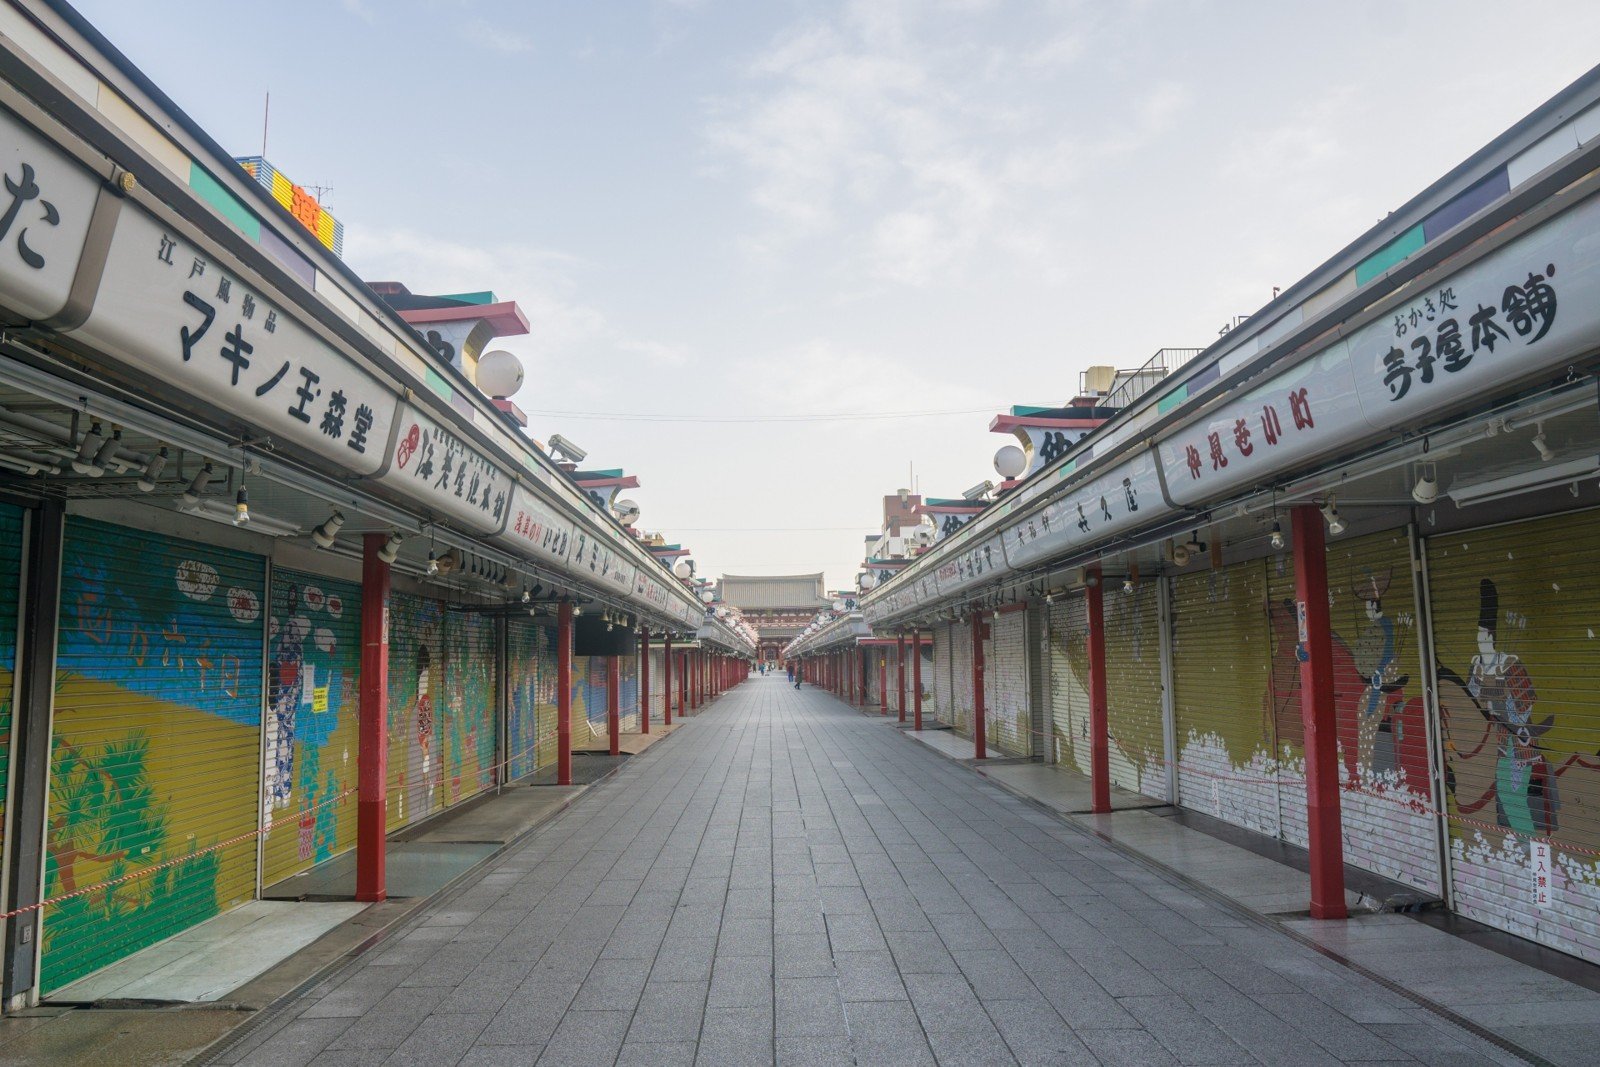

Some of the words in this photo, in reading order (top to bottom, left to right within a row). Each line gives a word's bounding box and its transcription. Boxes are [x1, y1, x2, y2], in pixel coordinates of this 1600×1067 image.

[157, 233, 278, 335] 江戸風物品
[1393, 287, 1459, 339] おかき処
[1383, 263, 1558, 402] 寺子屋本舗
[1185, 387, 1315, 480] 仲見世小町
[1536, 845, 1547, 904] 立入禁止
